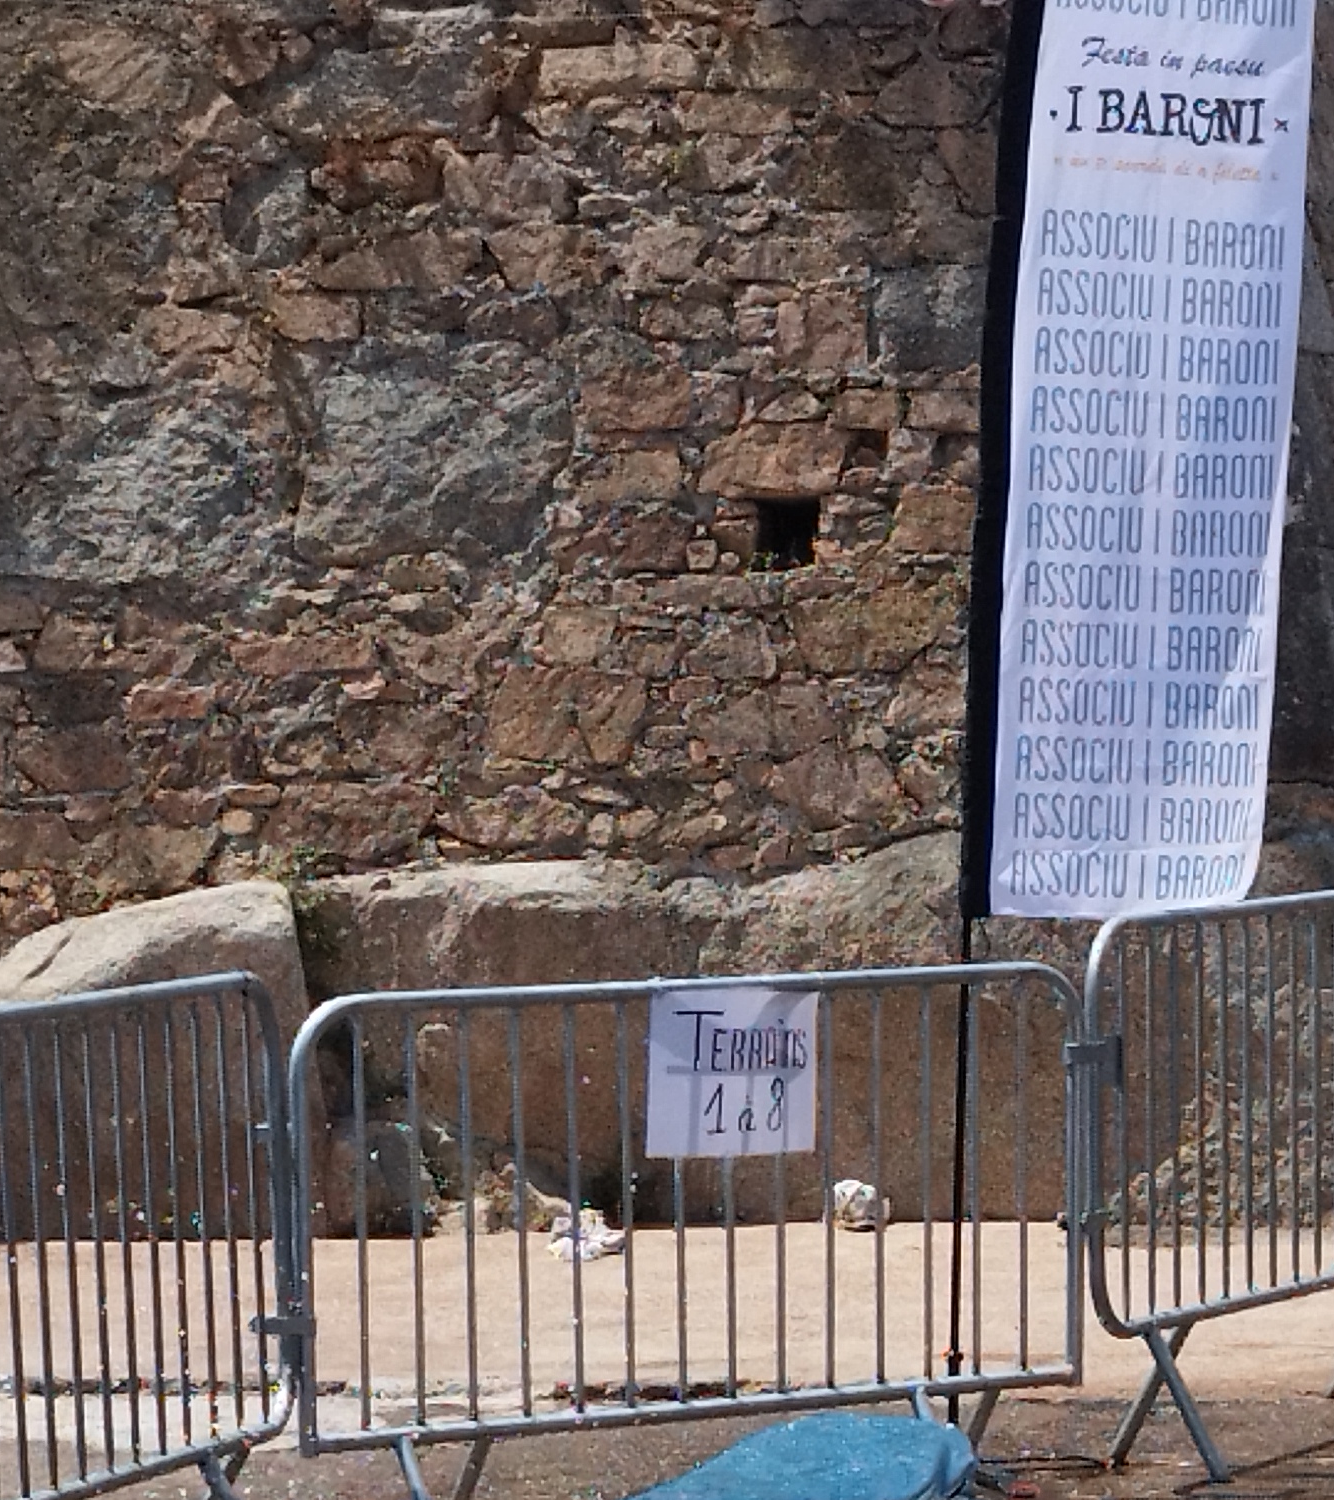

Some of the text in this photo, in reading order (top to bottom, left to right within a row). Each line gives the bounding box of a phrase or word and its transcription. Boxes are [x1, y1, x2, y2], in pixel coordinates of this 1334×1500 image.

[1160, 49, 1184, 71] in
[1065, 85, 1266, 146] I BARONI
[1041, 209, 1285, 271] ASSOCIU I BARONI
[1037, 267, 1283, 328] ASSOCIU I BARONI
[1034, 327, 1280, 386] ASSOCIU I BARONI
[1030, 386, 1276, 443] ASSOCIU I BARONI
[1028, 444, 1272, 500] ASSOCIU I BARONI
[1026, 502, 1271, 557] ASSOCIU I BARONI
[1023, 560, 1142, 612] ASSOCIU
[1150, 565, 1157, 612] I
[1020, 618, 1139, 670] ASSOCIU
[1148, 625, 1155, 670] I
[1018, 676, 1260, 731] ASSOCIU I BARONI
[1015, 735, 1259, 787] ASSOCIU I BARONI
[1013, 792, 1130, 842] ASSOCIU
[1141, 796, 1149, 842] I
[1009, 852, 1127, 899] ASSOCIU
[1138, 855, 1145, 899] I
[704, 1083, 726, 1134] 1
[768, 1077, 784, 1131] 8
